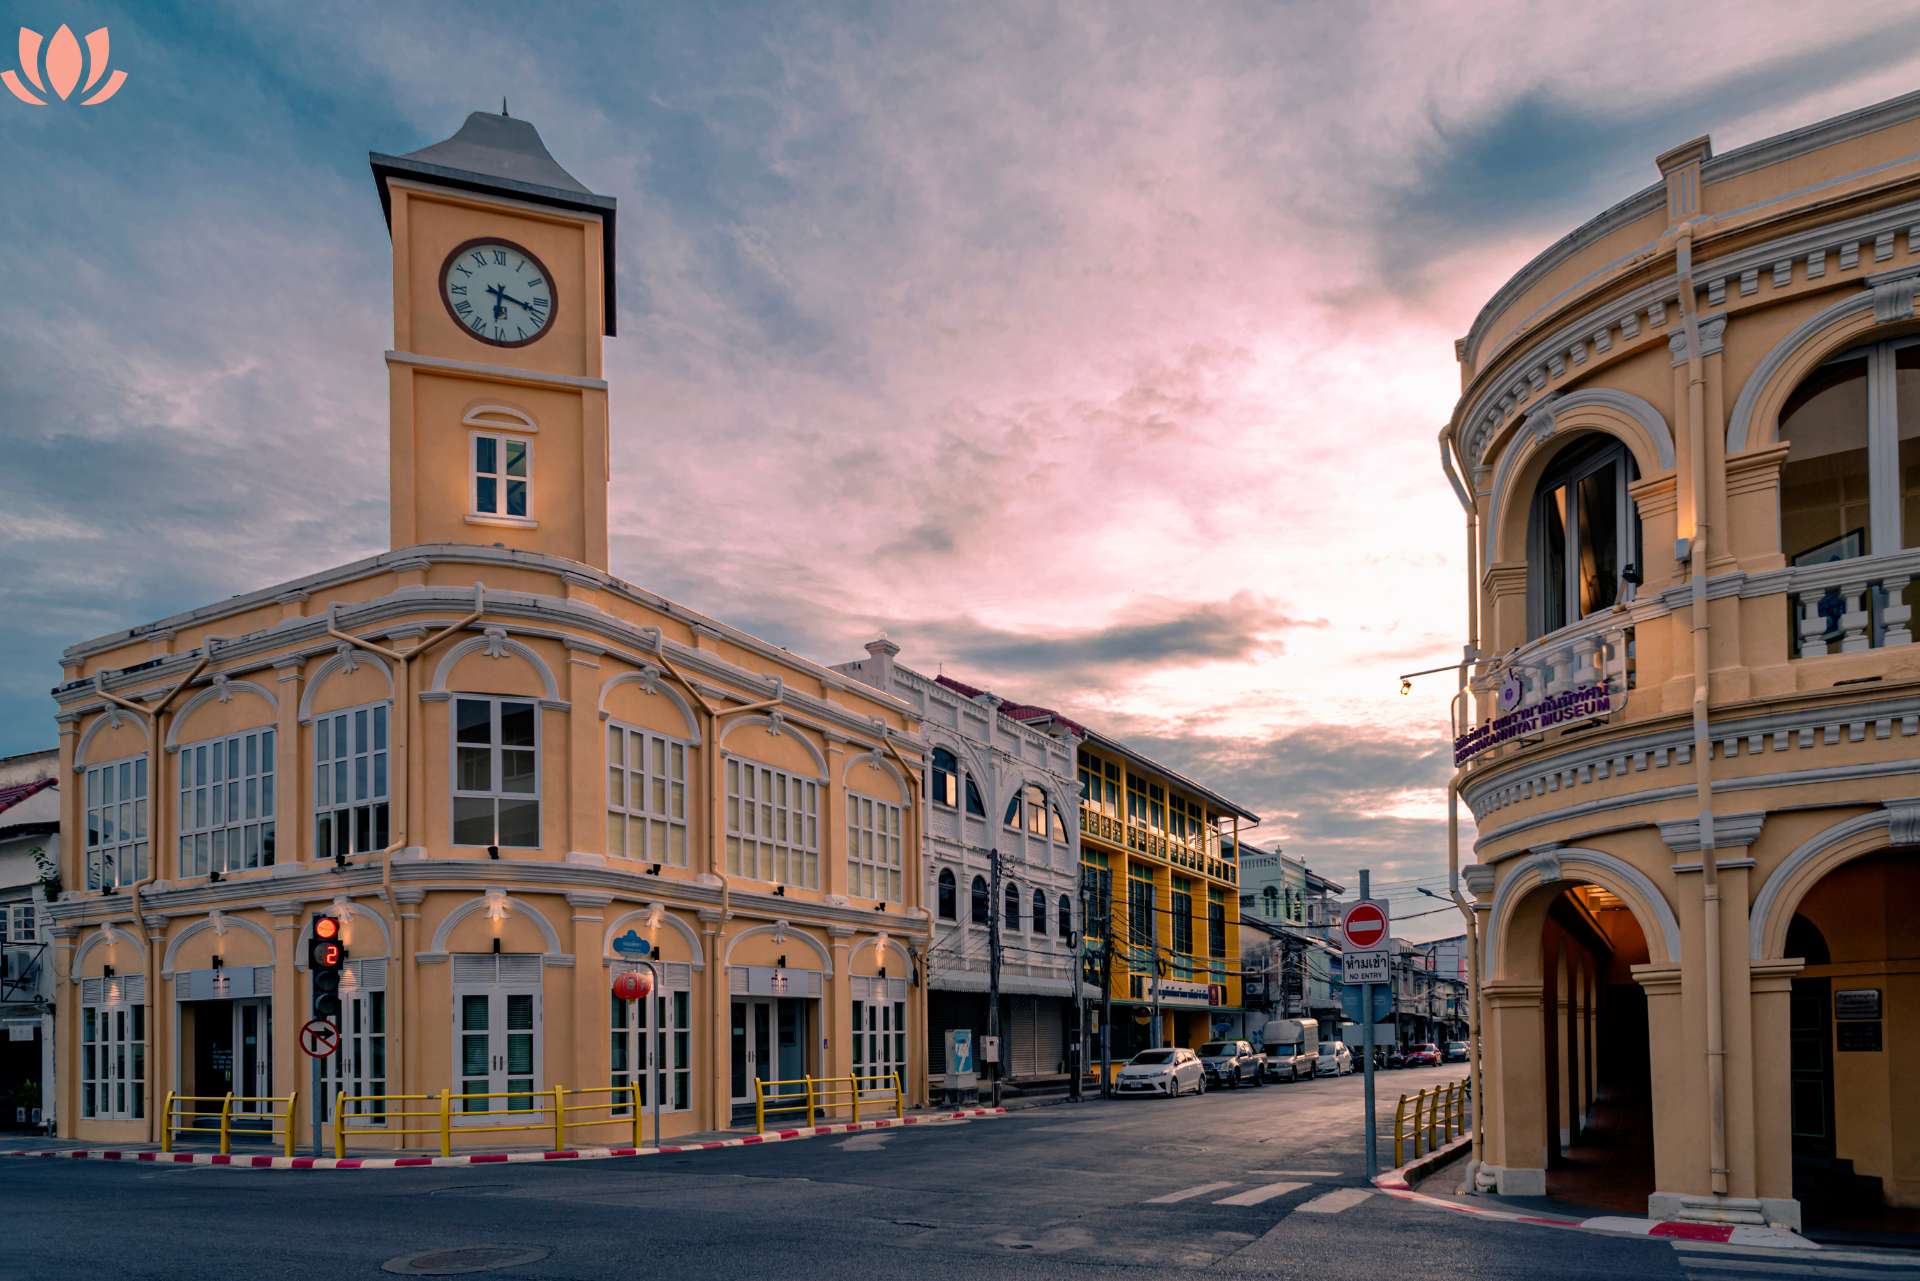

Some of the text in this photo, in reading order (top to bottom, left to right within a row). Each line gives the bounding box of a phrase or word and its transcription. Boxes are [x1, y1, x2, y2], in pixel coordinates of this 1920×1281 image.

[471, 251, 488, 267] XI
[493, 250, 506, 266] XII
[456, 264, 472, 278] X
[515, 260, 525, 272] I
[451, 284, 467, 295] IX
[528, 278, 543, 287] II
[533, 297, 548, 307] III
[1541, 697, 1610, 727] MUSEUM
[327, 946, 337, 964] 2
[1345, 954, 1387, 970] ห้ามเข้า
[1360, 972, 1383, 980] ENTRY
